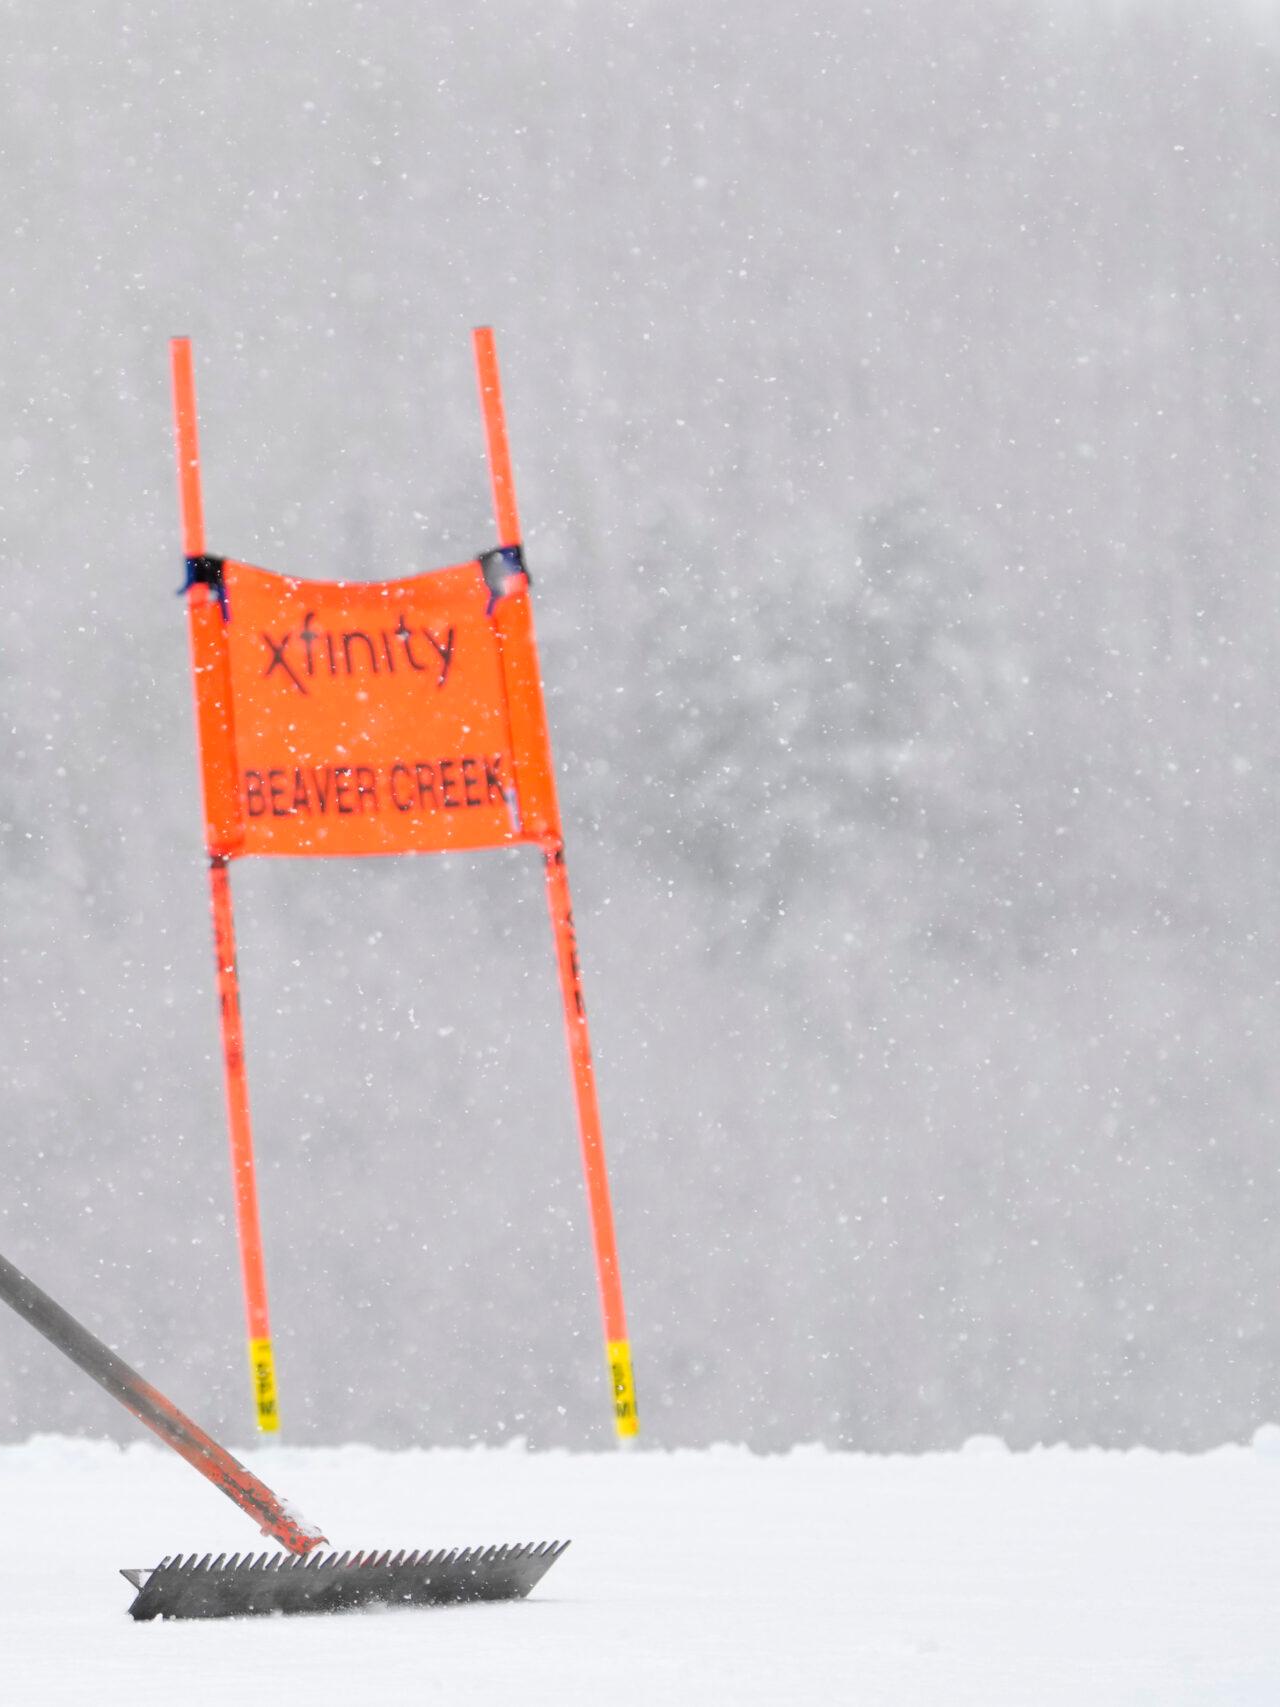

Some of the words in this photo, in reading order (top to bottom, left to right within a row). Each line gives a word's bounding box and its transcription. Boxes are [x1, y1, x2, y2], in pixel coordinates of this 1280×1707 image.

[263, 612, 455, 695] xfinity
[245, 765, 380, 817] BEAVER
[389, 756, 510, 812] CREEK
